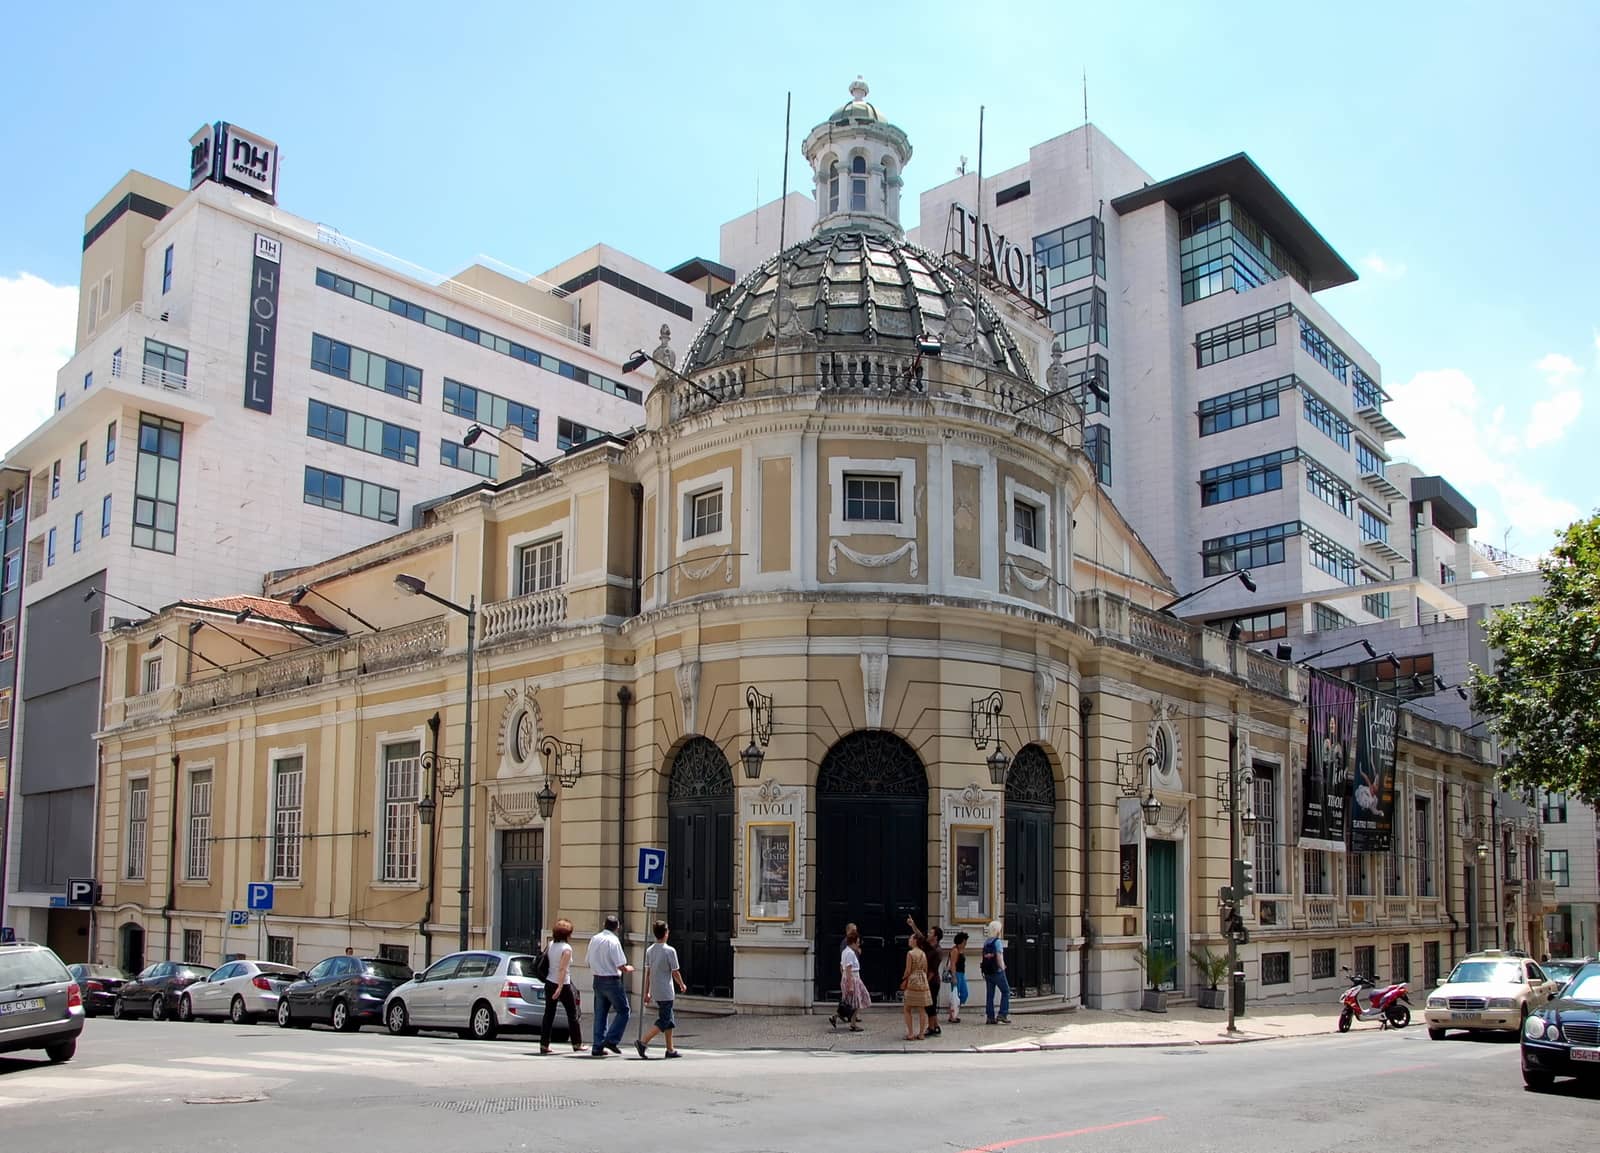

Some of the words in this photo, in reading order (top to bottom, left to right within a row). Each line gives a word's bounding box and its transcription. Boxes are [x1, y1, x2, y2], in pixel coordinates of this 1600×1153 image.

[232, 162, 267, 182] HOTELES
[952, 202, 1052, 312] TIVOLI
[252, 268, 275, 403] HOTEL
[750, 803, 793, 815] TIVOLI
[953, 806, 991, 820] TIVOLI
[644, 854, 660, 880] P
[72, 882, 91, 901] P
[253, 886, 268, 907] P
[15, 1000, 27, 1010] CV
